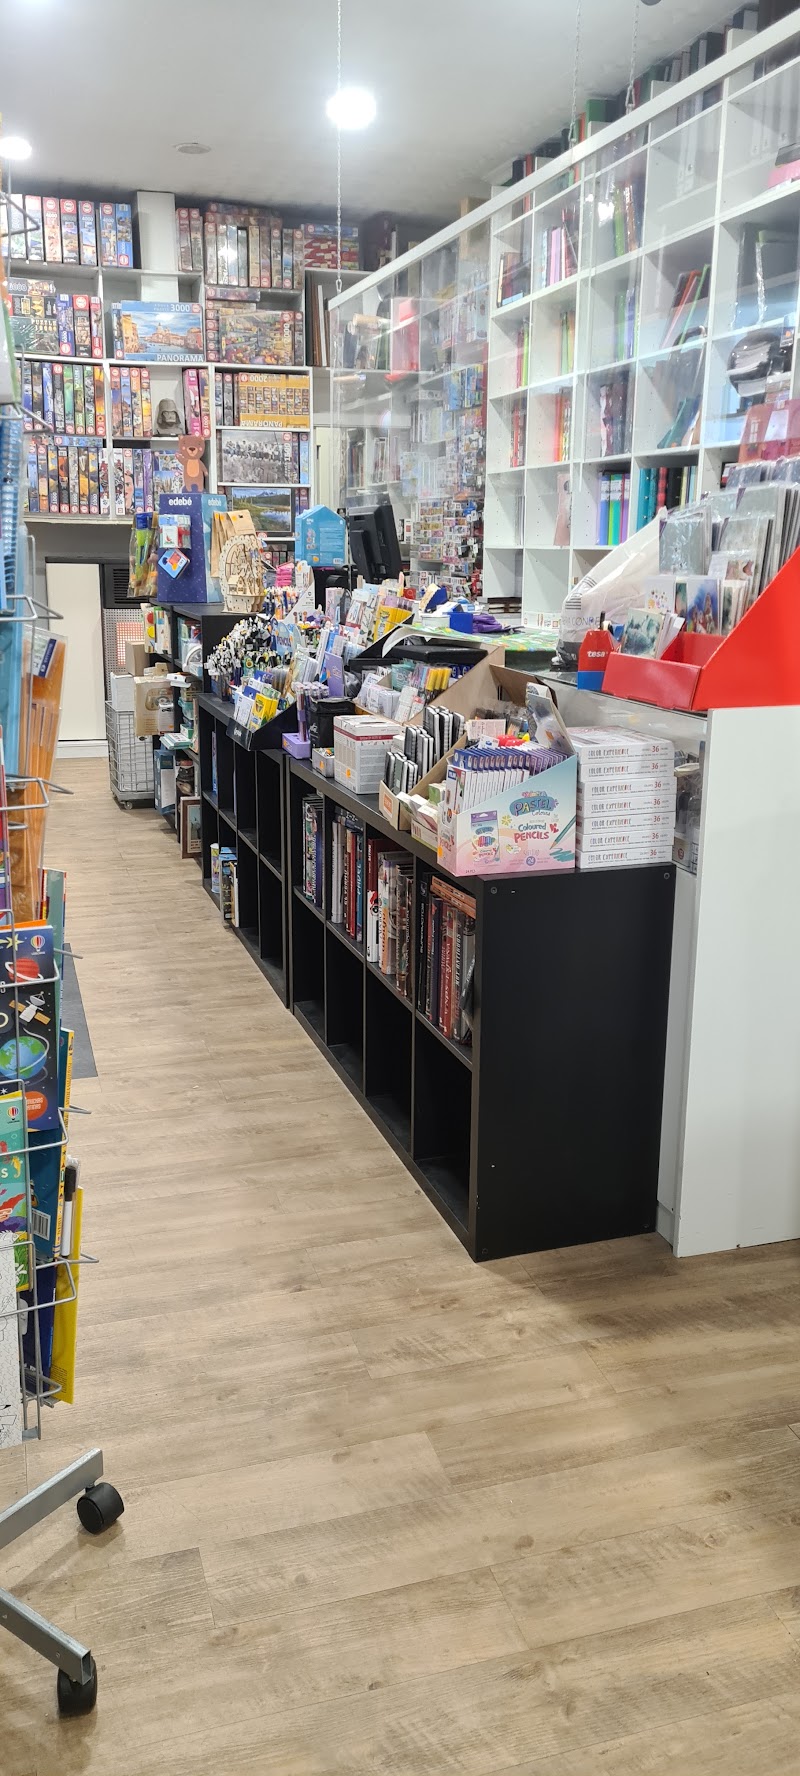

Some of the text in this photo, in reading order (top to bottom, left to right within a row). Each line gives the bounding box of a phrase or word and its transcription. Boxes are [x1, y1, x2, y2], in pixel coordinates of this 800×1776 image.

[170, 304, 190, 312] 3000
[168, 497, 192, 506] edebé
[514, 798, 552, 816] PASTEL
[518, 823, 546, 832] Coloured
[513, 831, 549, 843] PENCILS
